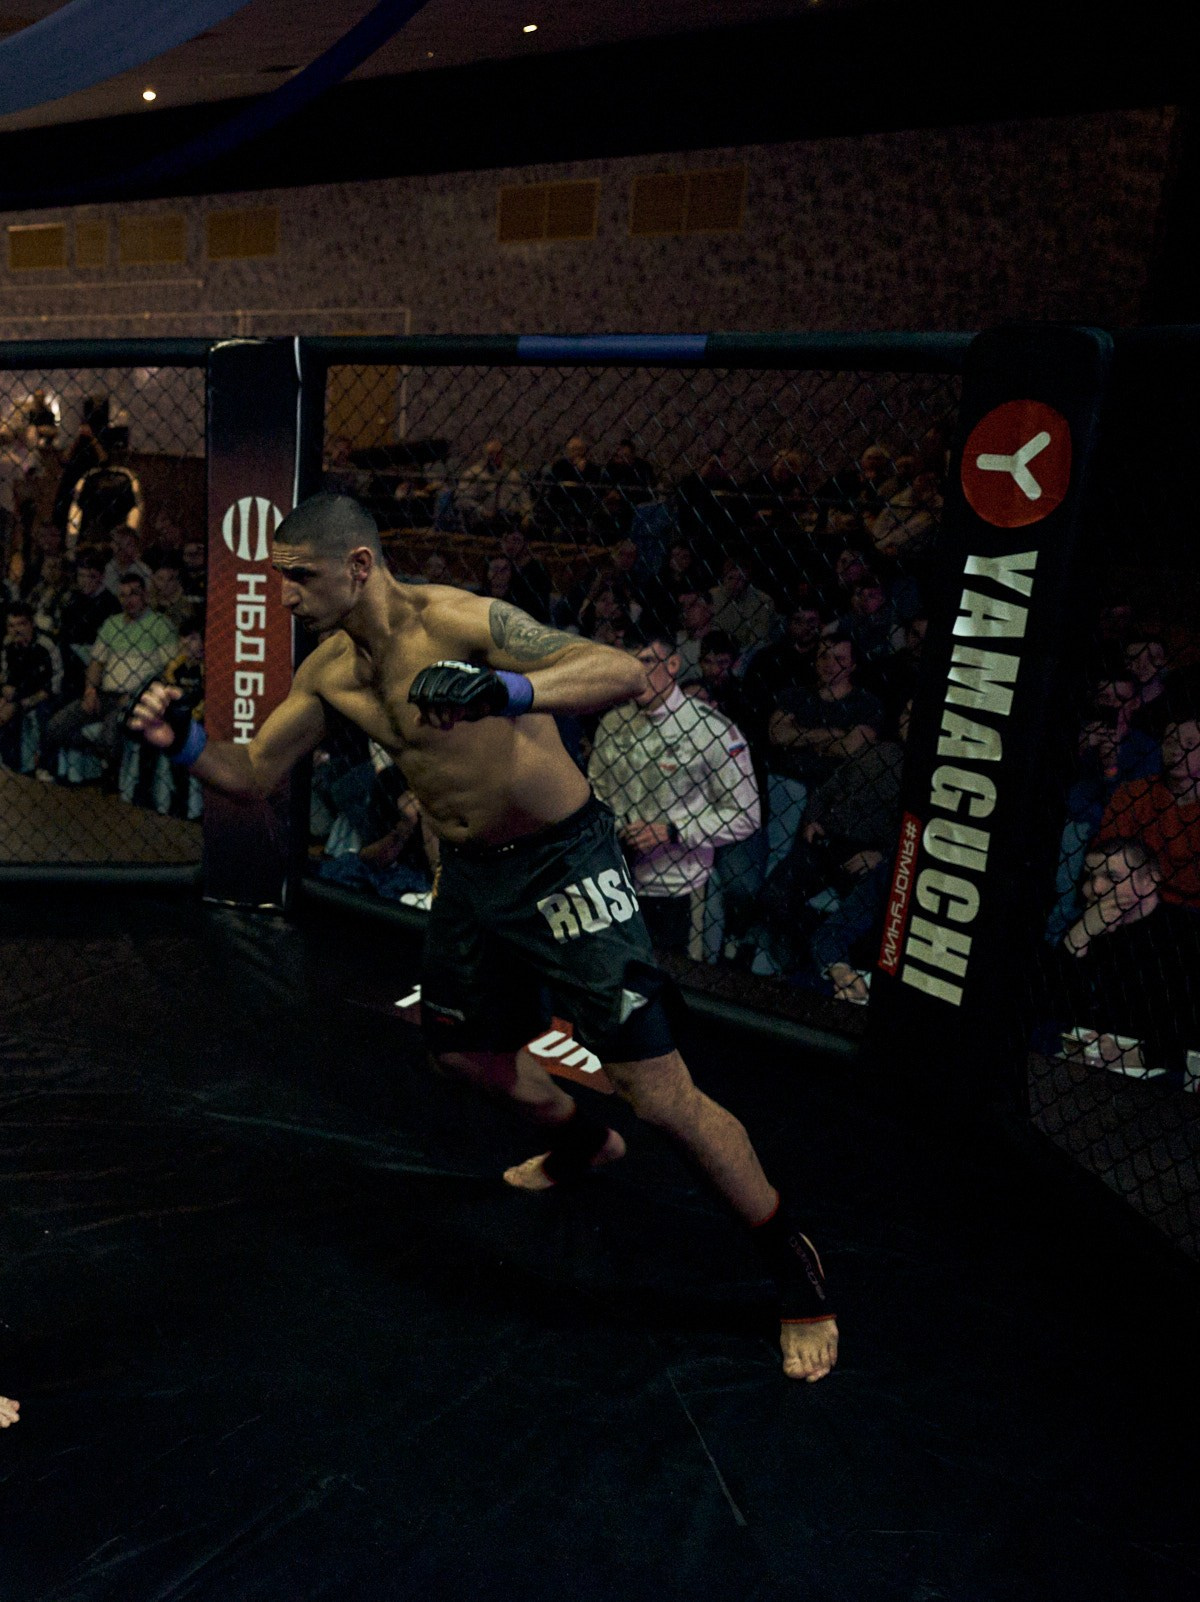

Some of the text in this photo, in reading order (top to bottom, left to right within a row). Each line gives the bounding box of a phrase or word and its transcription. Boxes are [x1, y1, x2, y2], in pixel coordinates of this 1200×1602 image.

[233, 573, 267, 745] НБД Бан
[901, 550, 1039, 1007] YAMAGUCHI
